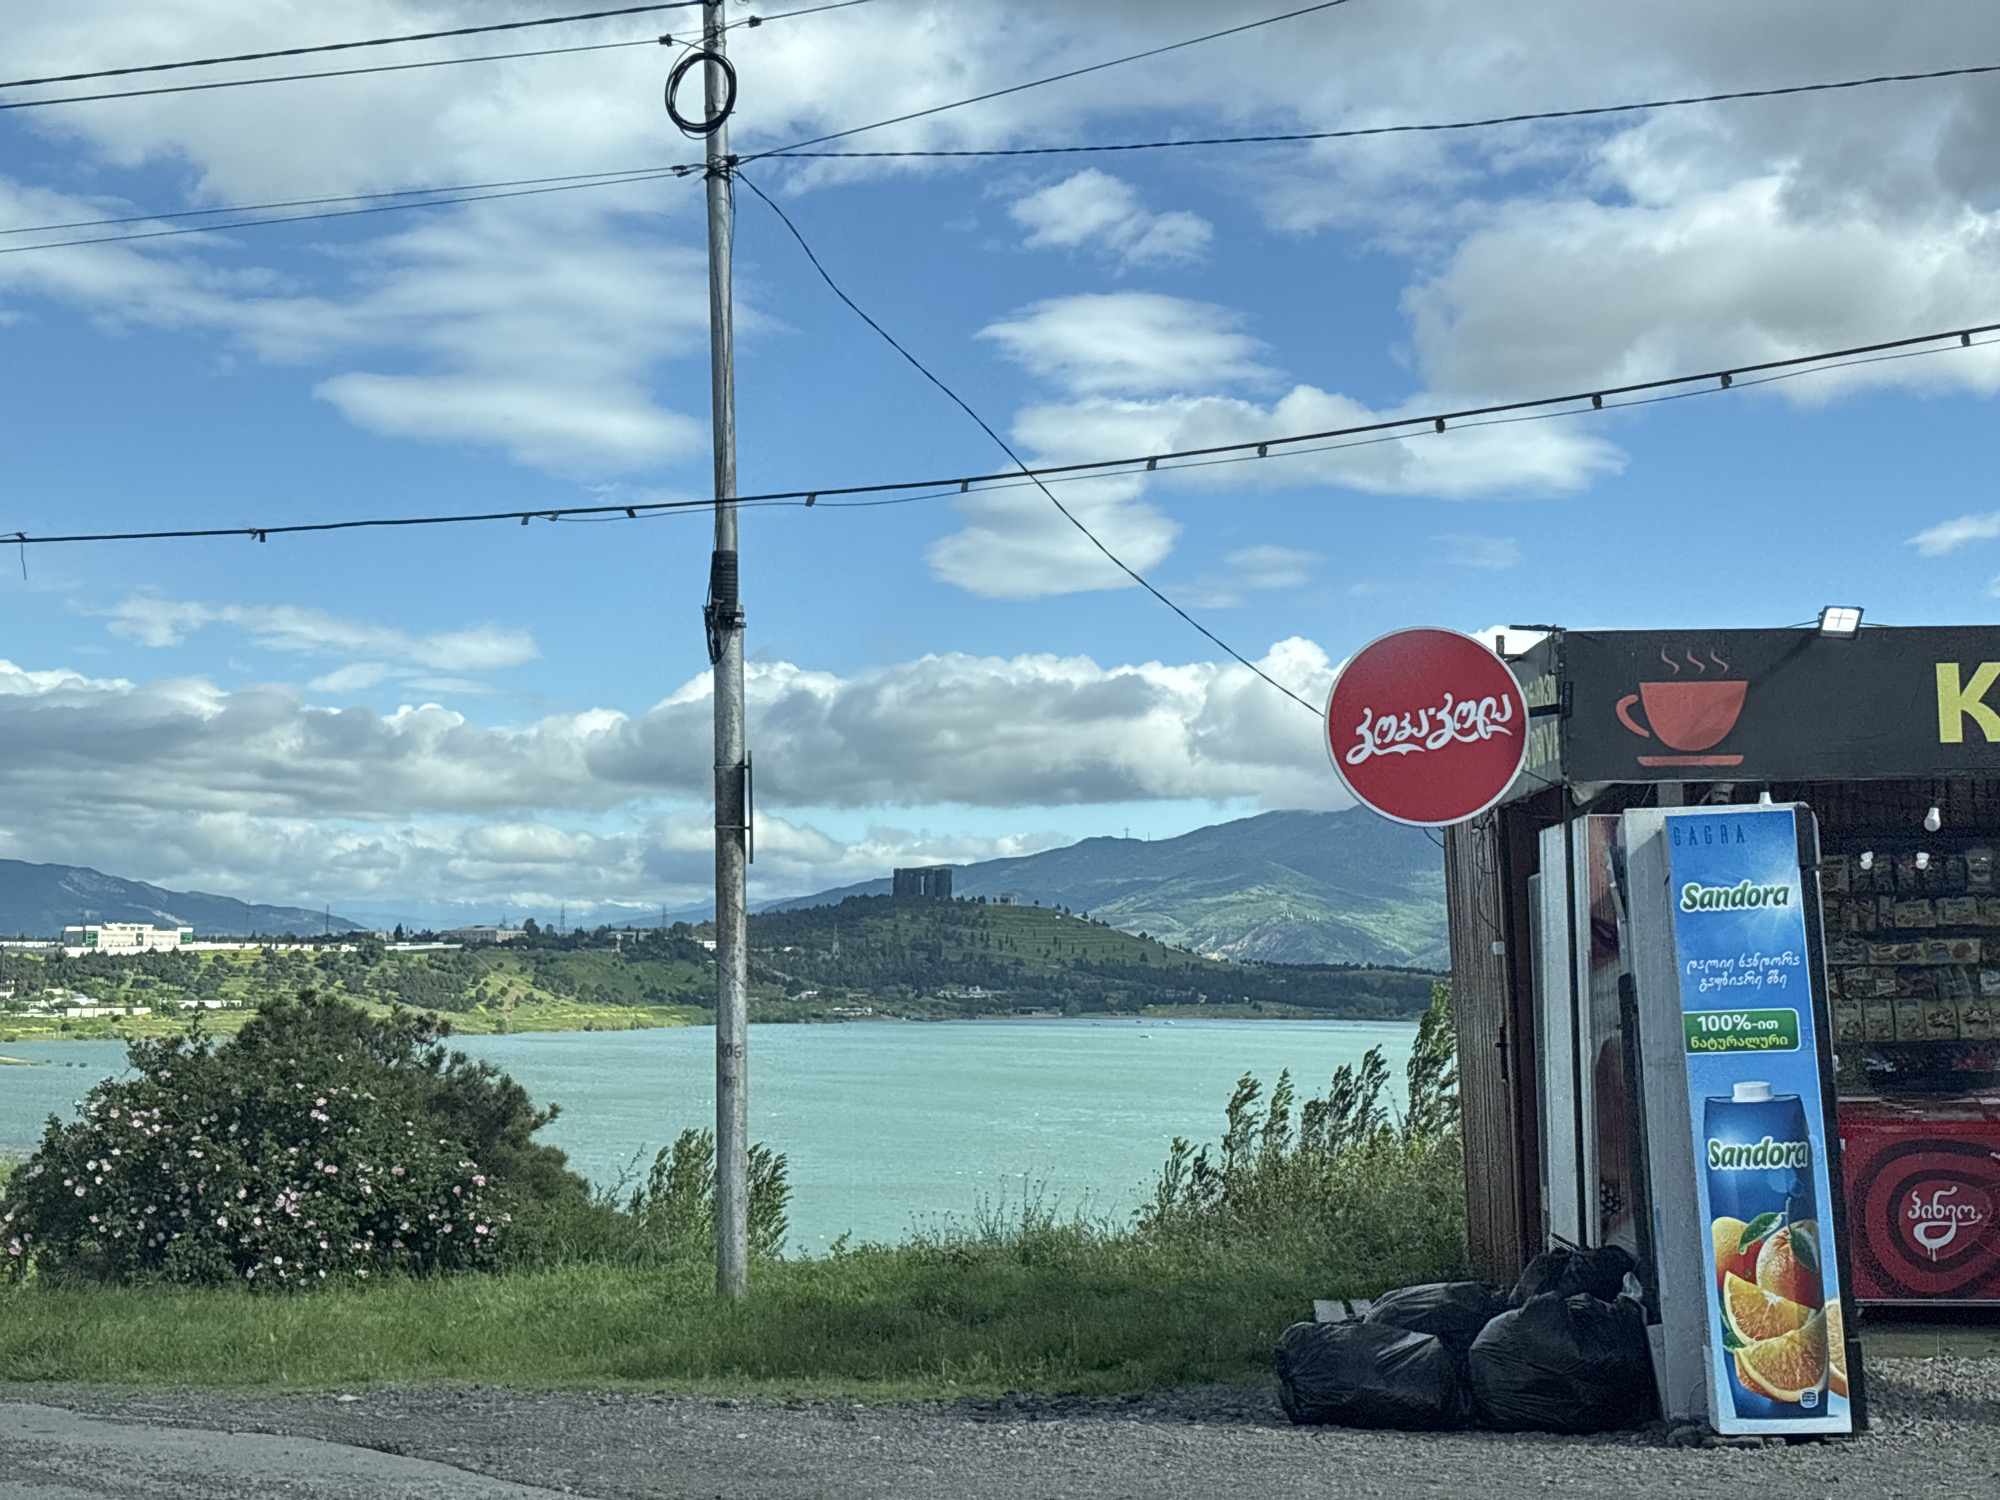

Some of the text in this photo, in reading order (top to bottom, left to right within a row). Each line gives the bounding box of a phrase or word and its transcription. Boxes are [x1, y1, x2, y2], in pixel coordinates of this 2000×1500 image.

[1346, 692, 1513, 765] კოკა-კოლა
[1673, 823, 1745, 846] GAGRA
[1681, 879, 1791, 911] Sandora
[1686, 950, 1801, 975] დალიე სანდორა
[1697, 1013, 1779, 1032] 100%-ით
[1690, 1033, 1789, 1051] ნატურალური
[1708, 1137, 1808, 1168] Sandora
